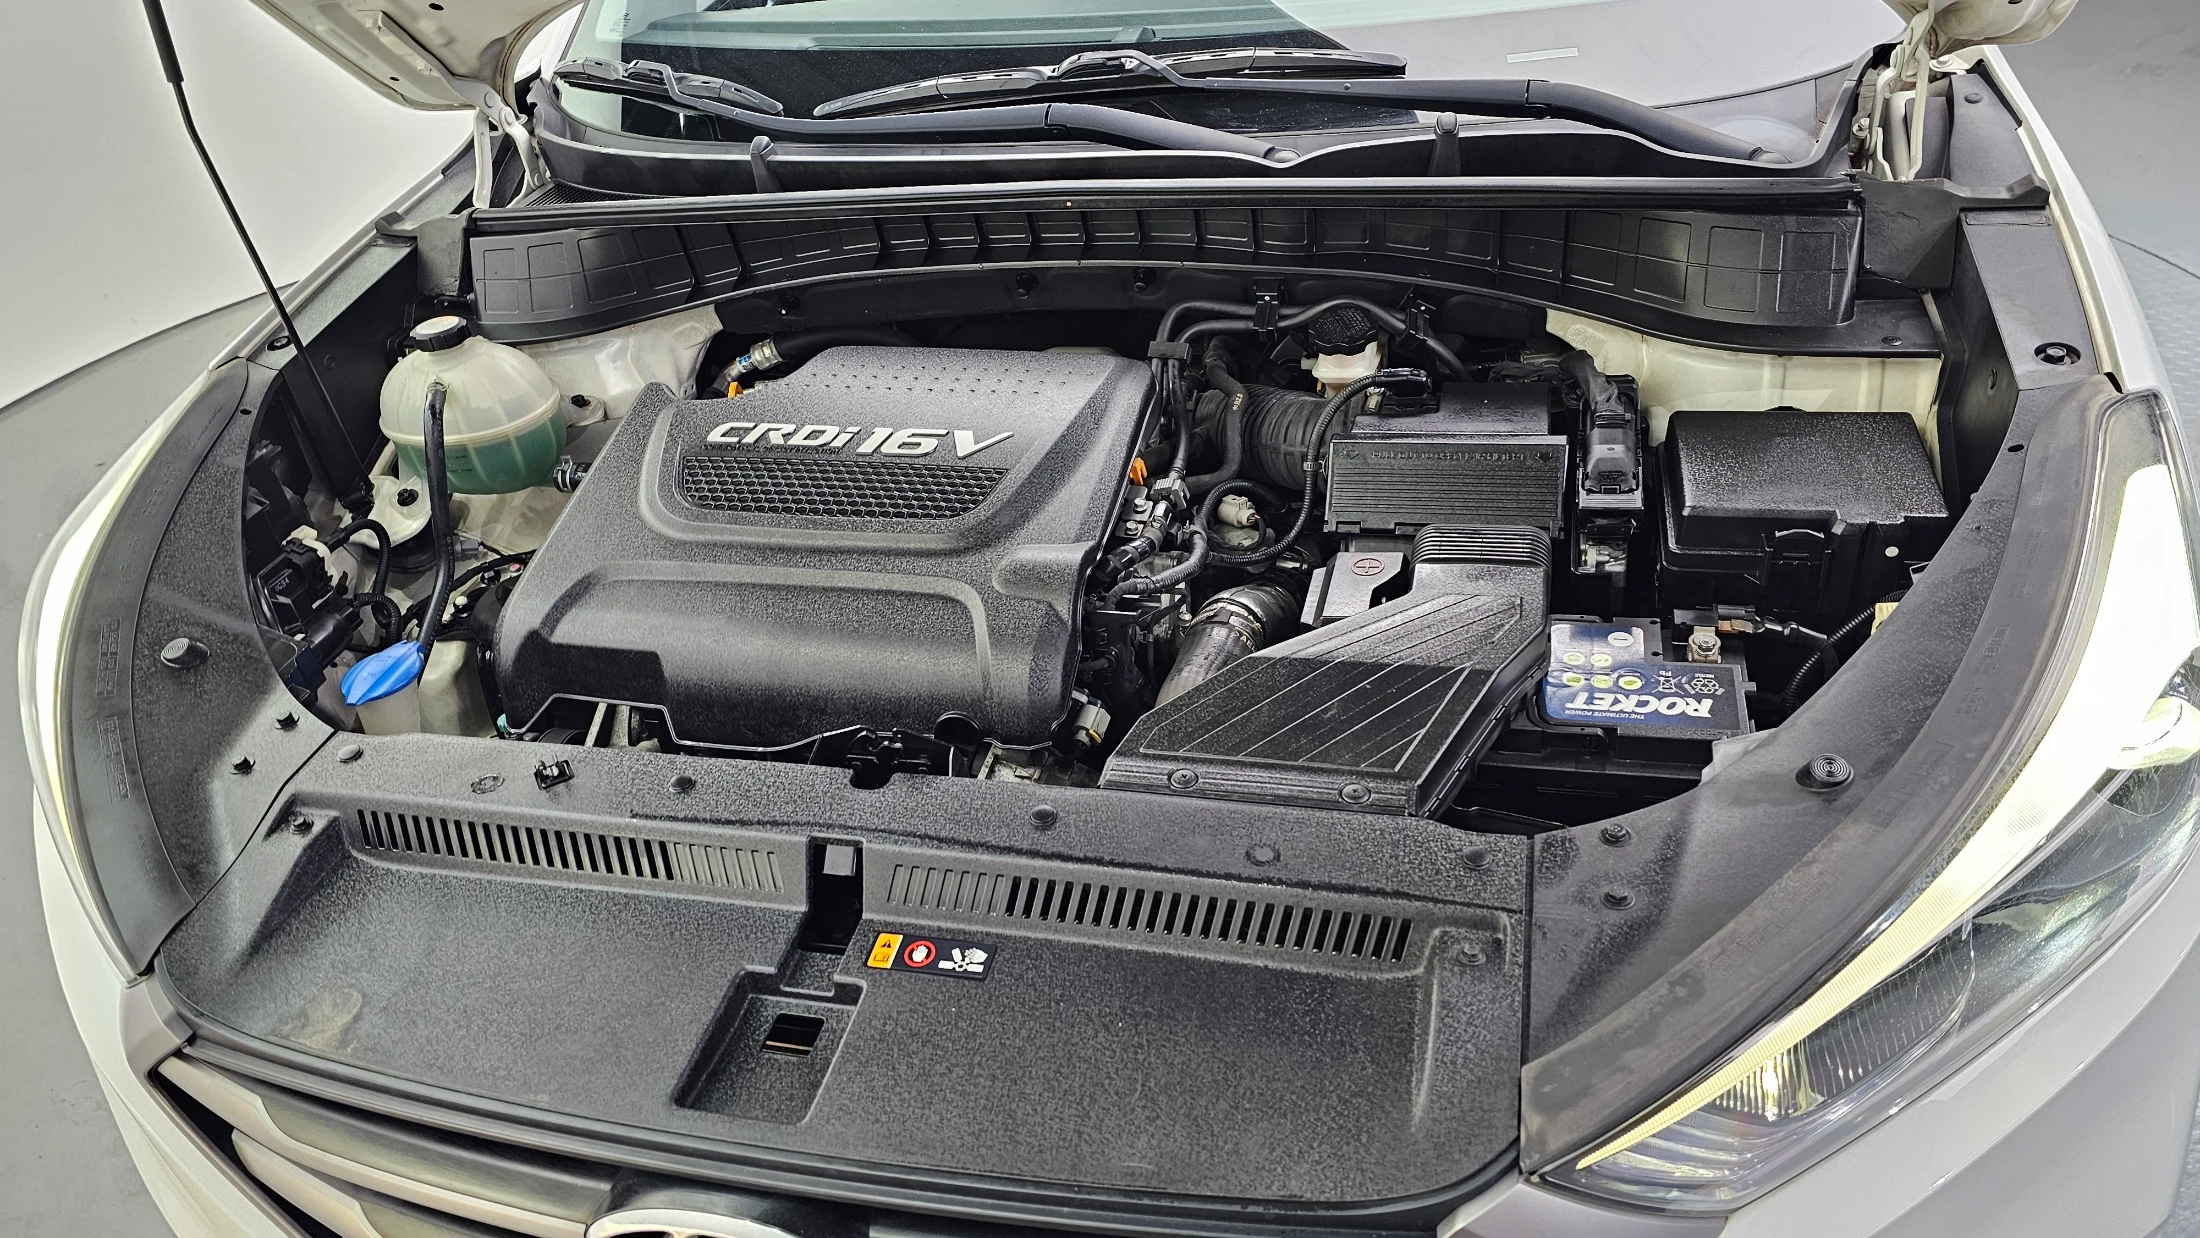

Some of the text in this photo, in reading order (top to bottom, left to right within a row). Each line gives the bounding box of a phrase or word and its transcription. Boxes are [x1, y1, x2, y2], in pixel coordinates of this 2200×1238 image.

[706, 421, 862, 448] CRDi
[1564, 691, 1714, 718] ROCKET
[1592, 711, 1629, 719] ULTIMATE
